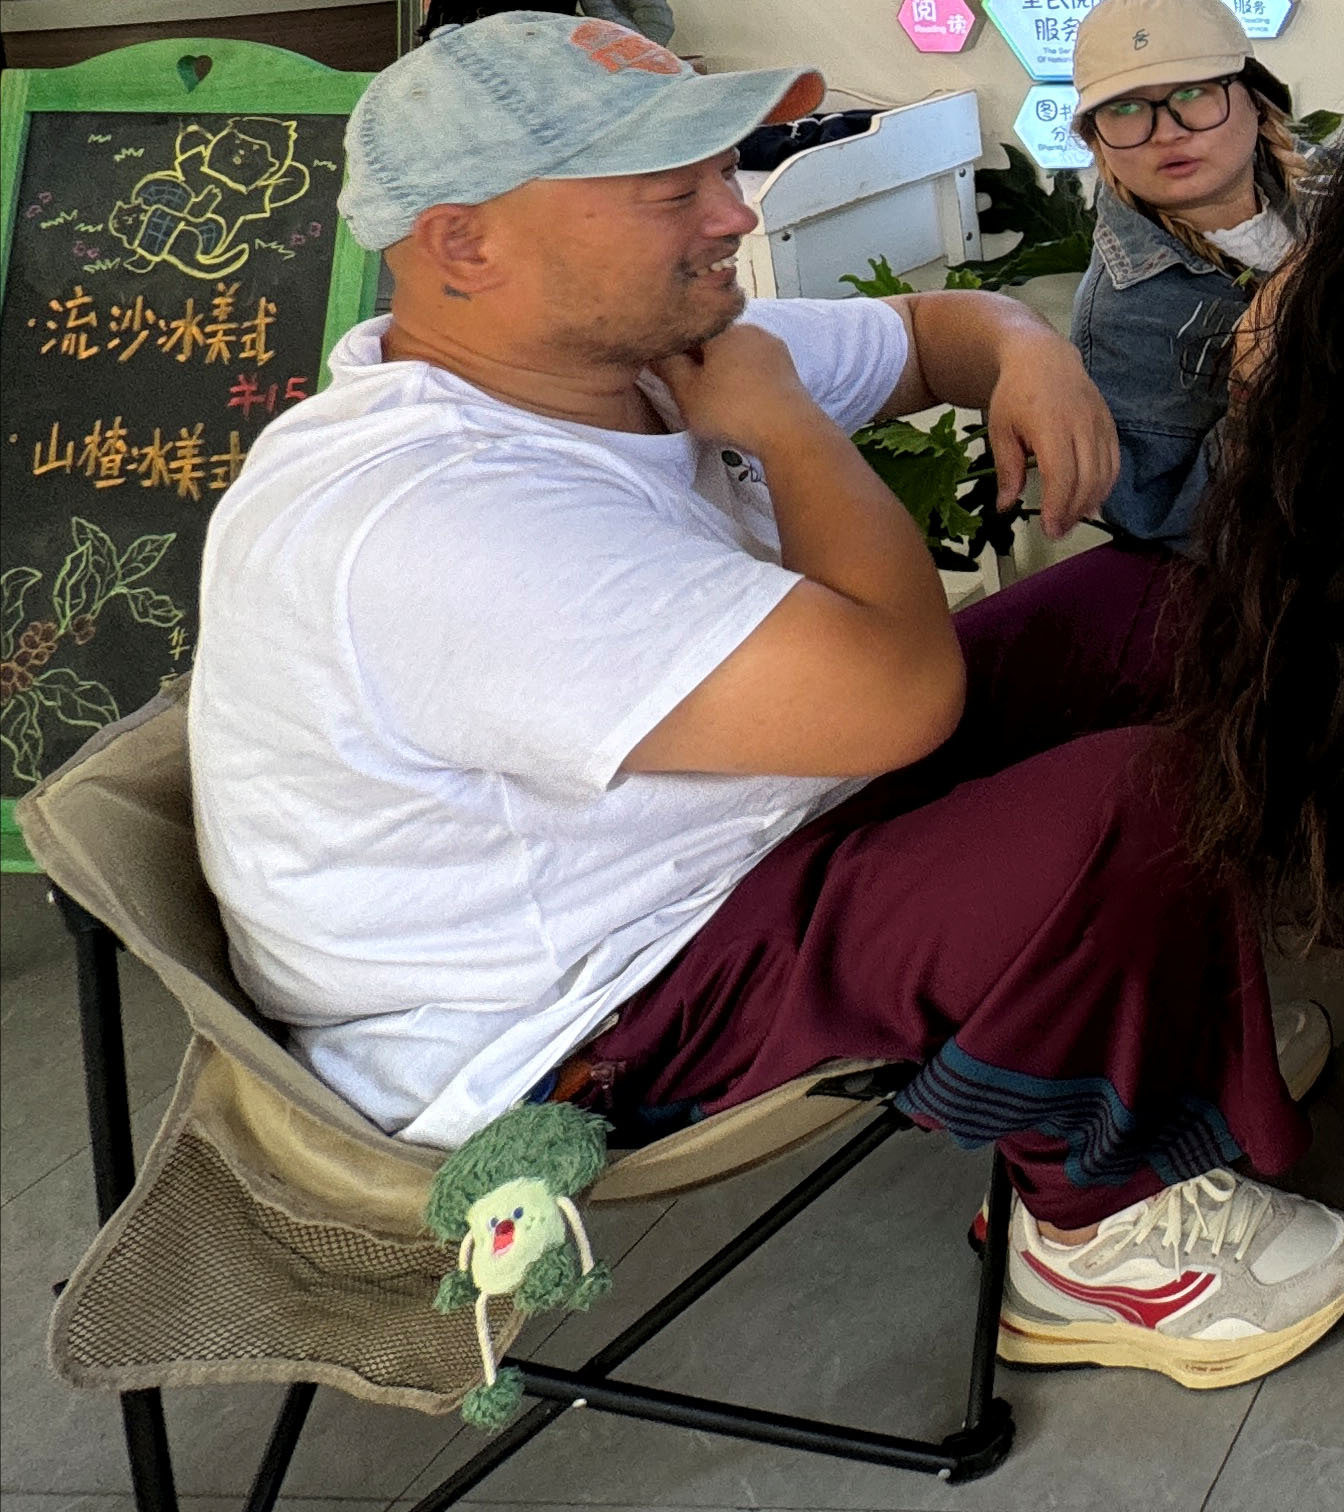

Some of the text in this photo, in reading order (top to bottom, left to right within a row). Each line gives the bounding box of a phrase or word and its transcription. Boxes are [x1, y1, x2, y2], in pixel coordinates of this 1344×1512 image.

[40, 282, 277, 366] 流沙冰美式
